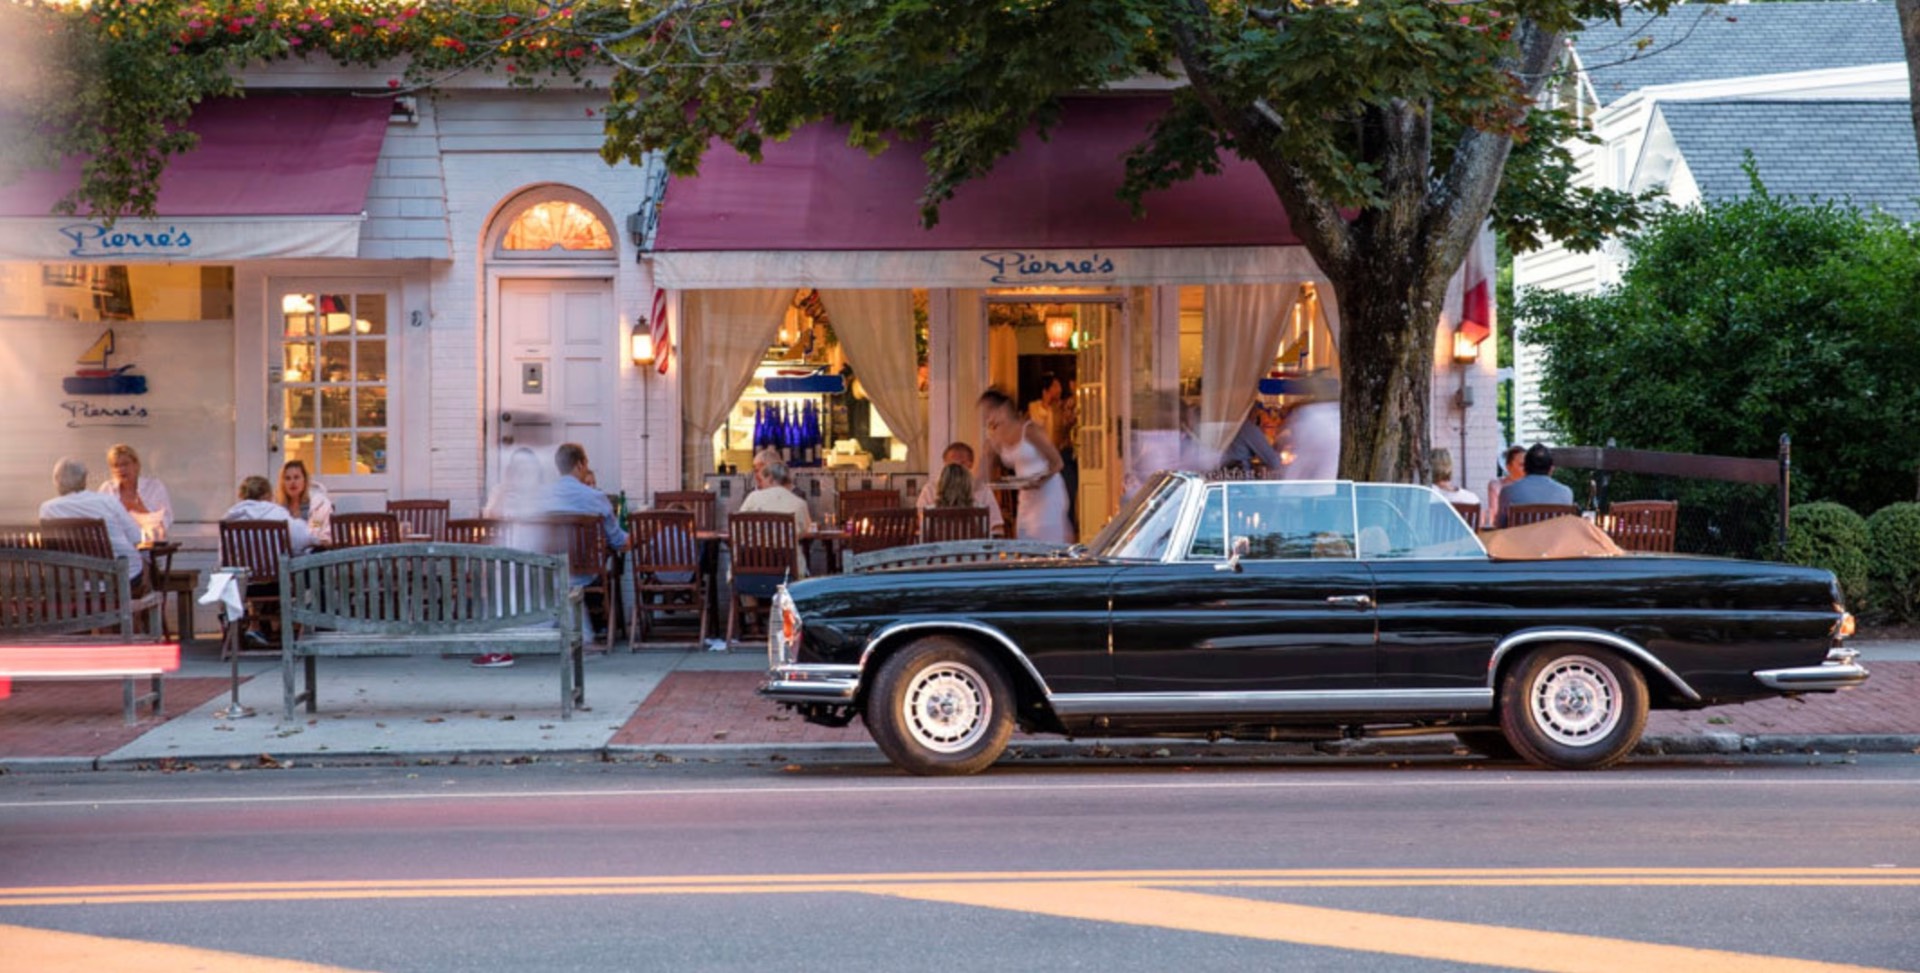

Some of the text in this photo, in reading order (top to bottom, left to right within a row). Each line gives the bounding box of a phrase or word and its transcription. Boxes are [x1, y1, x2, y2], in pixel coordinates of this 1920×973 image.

[59, 223, 192, 257] Pierre's
[980, 251, 1114, 284] Pierre's
[60, 400, 148, 428] Pierre's
[1200, 466, 1256, 480] reakfast
